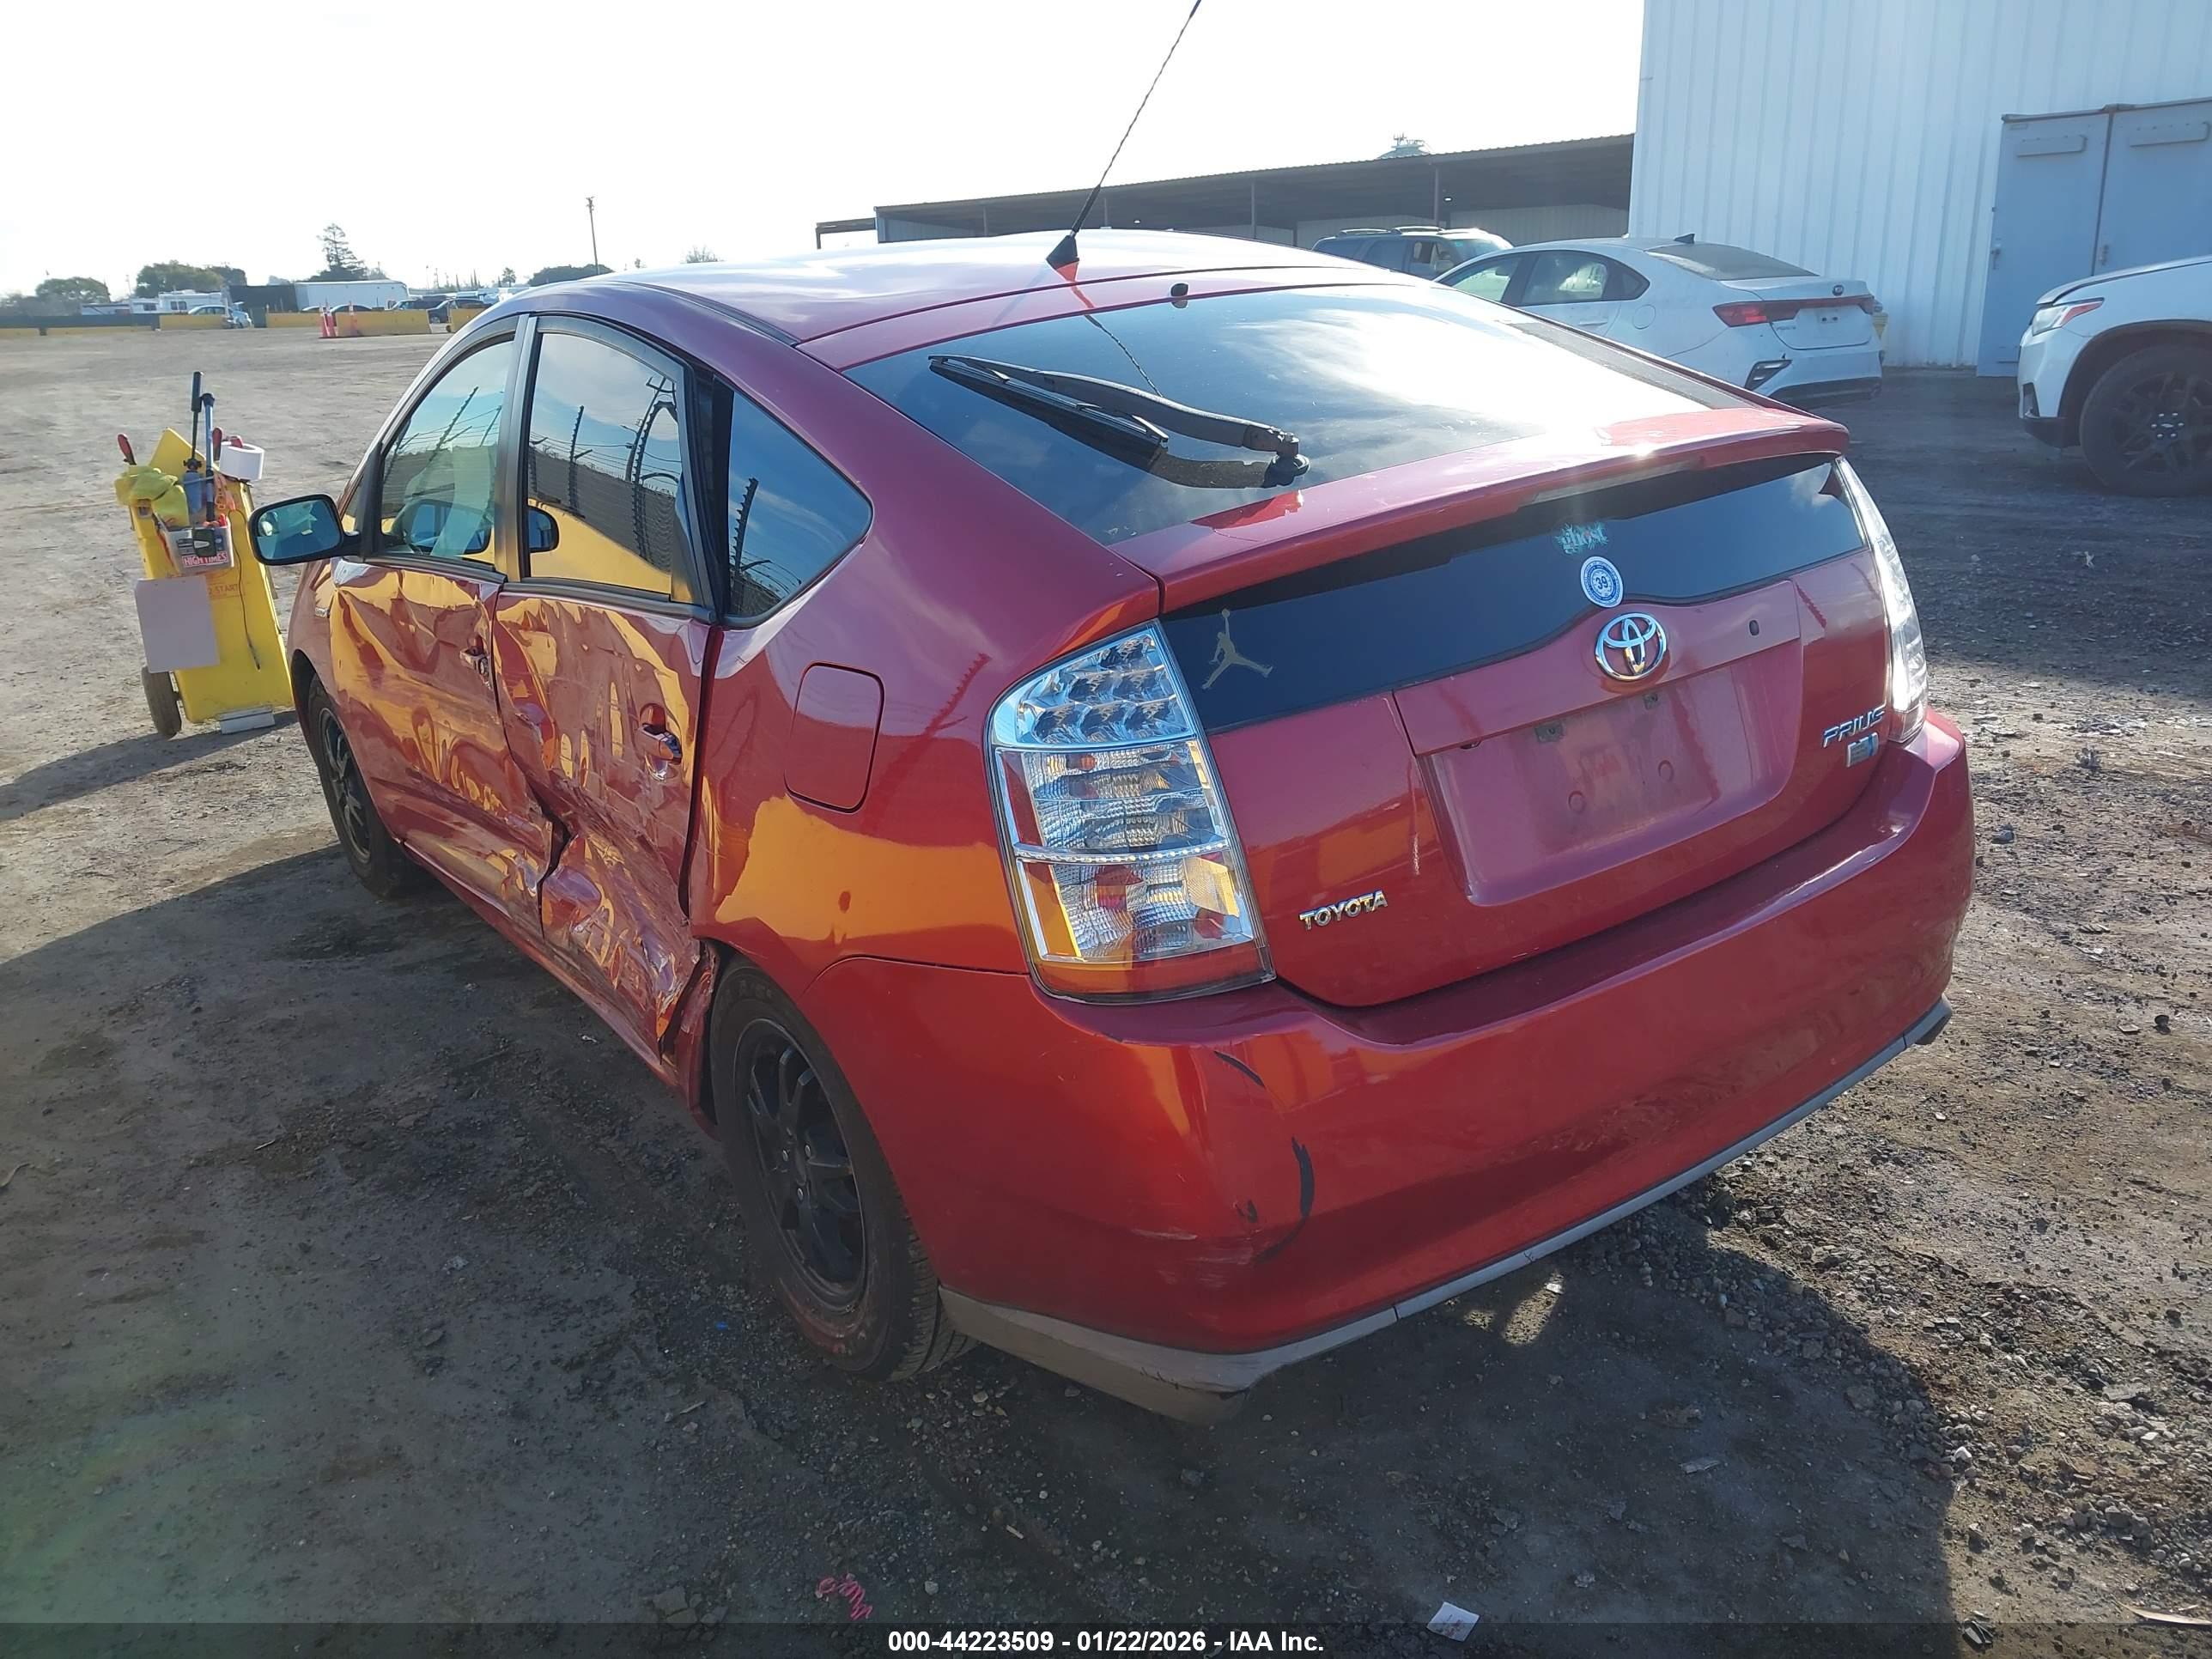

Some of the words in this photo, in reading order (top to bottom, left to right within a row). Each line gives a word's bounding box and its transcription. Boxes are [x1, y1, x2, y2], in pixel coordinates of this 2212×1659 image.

[1595, 575, 1609, 590] 39
[1823, 703, 1886, 748] PRIUS
[1298, 890, 1388, 930] TOYOTA
